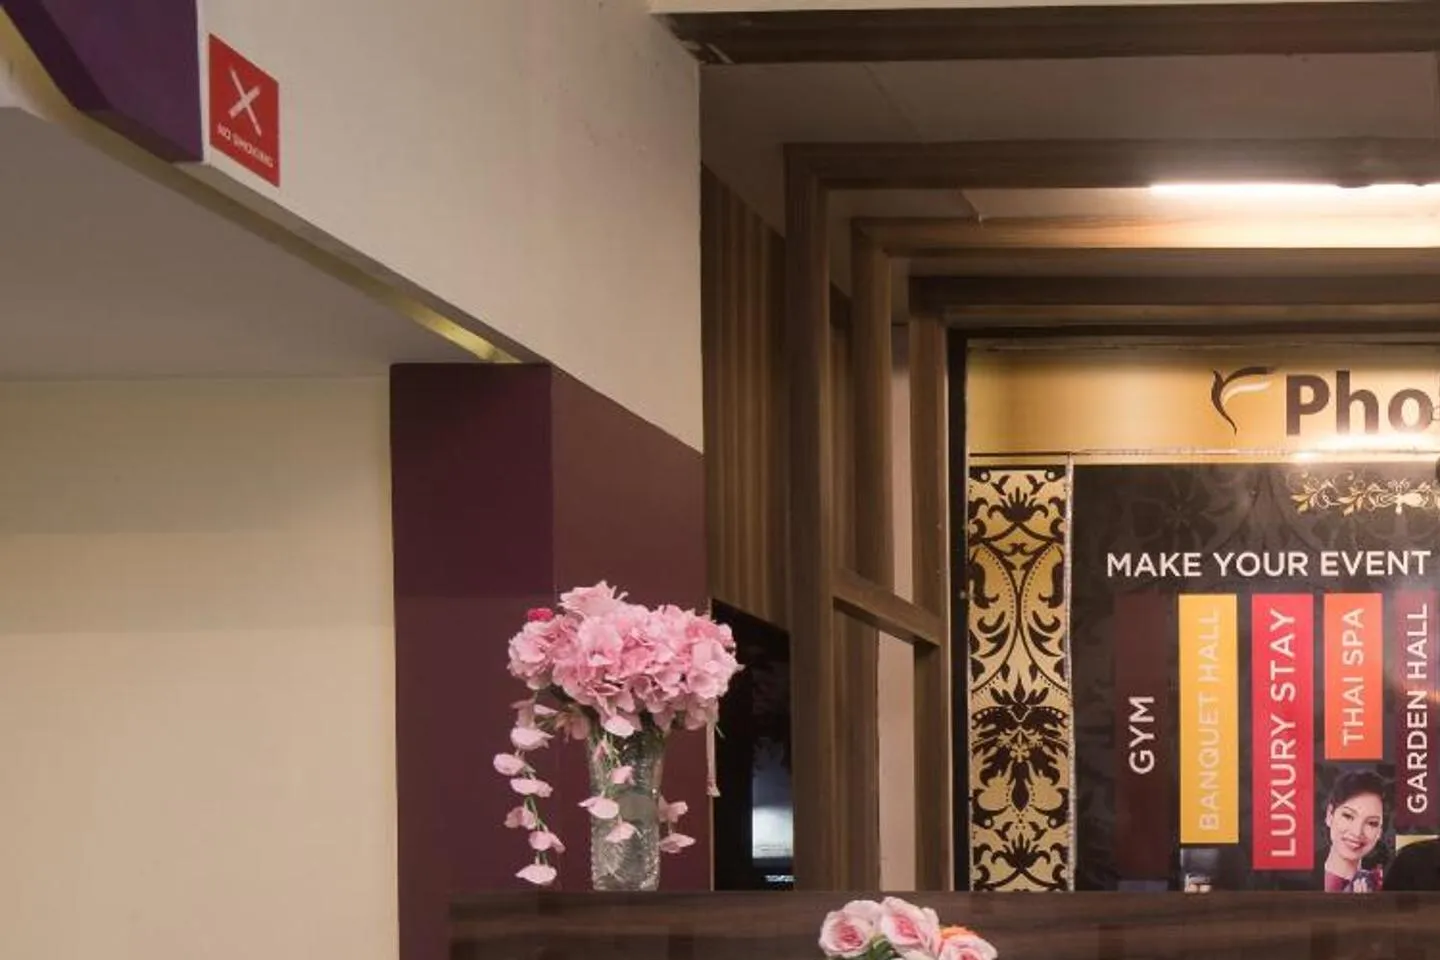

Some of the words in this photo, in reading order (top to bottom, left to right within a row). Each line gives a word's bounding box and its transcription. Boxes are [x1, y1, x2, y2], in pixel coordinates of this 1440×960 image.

[1106, 551, 1202, 577] MAKE
[1212, 551, 1308, 577] YOUR
[1321, 550, 1431, 576] EVENT
[1198, 607, 1220, 682] HALL
[1269, 609, 1296, 702] STAY
[1342, 608, 1365, 666] SPA
[1406, 603, 1428, 675] HALL
[1128, 696, 1155, 774] GYM
[1342, 676, 1365, 746] THAI
[1198, 692, 1220, 830] BANQUET
[1270, 714, 1297, 857] LUXURY
[1406, 685, 1428, 814] GARDEN
